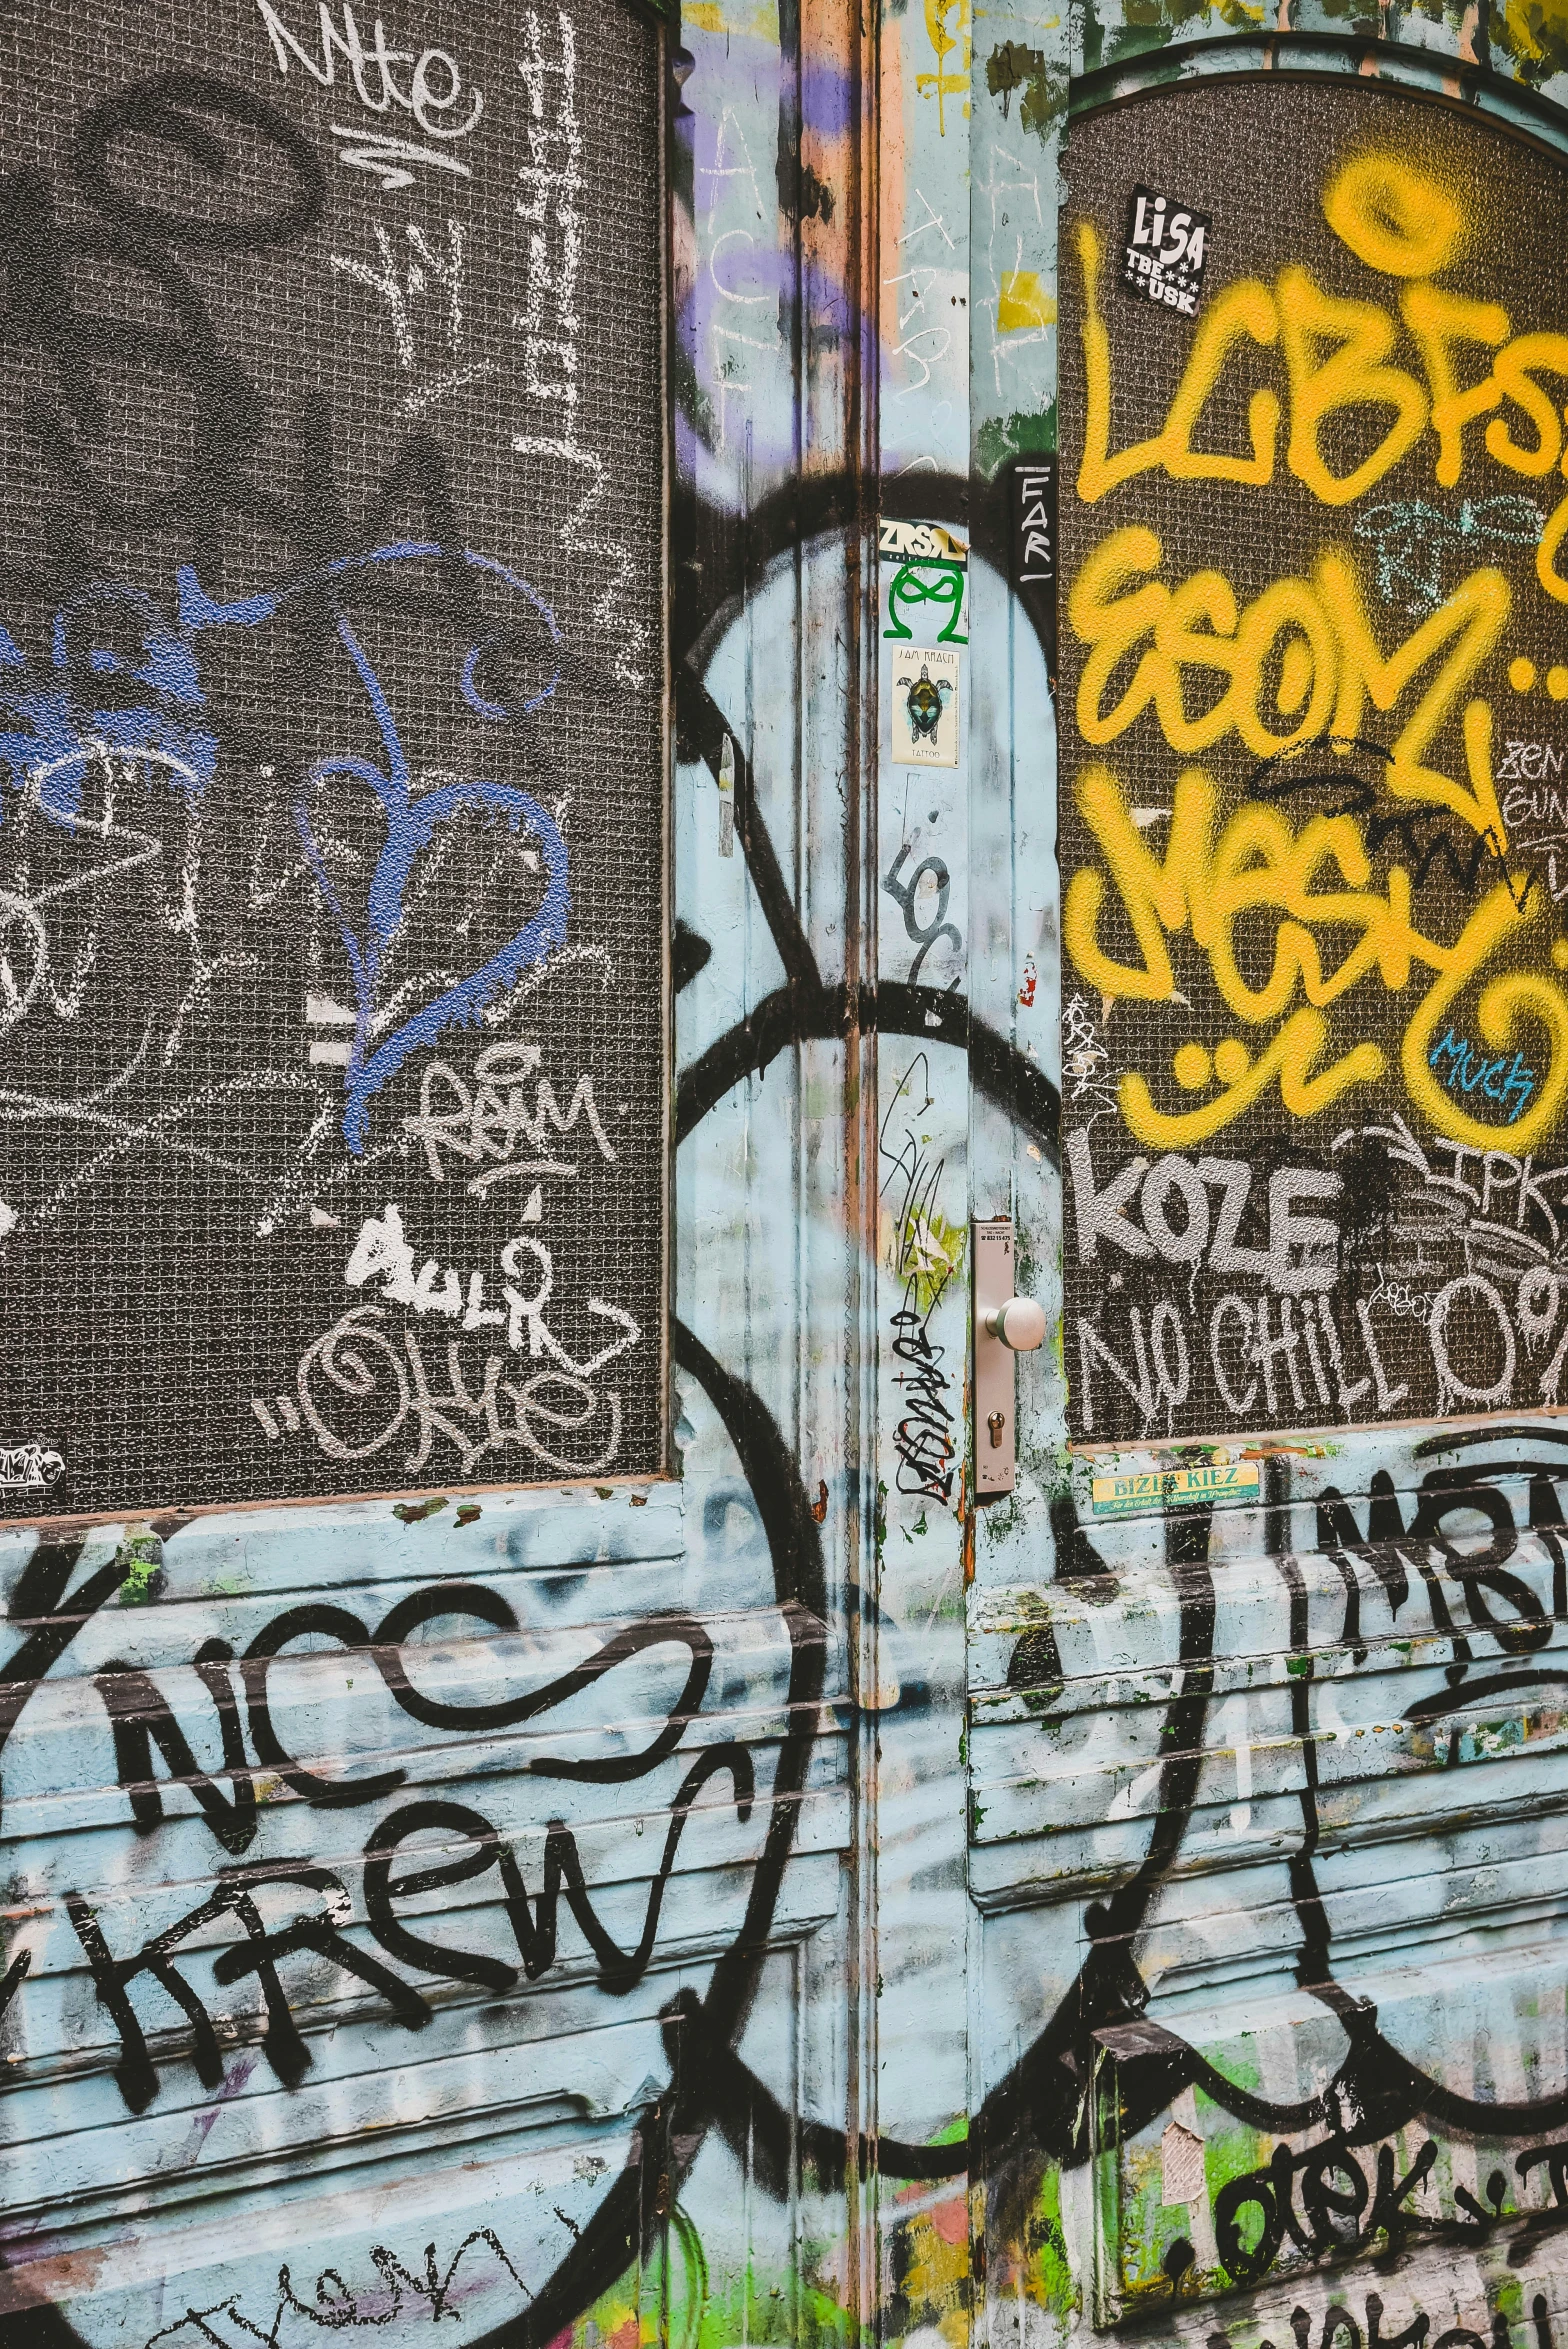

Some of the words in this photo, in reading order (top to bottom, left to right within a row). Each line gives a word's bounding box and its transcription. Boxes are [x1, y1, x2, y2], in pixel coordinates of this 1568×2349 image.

[1126, 247, 1165, 281] TBE
[1148, 277, 1196, 315] USK
[898, 648, 920, 661] SAM
[924, 651, 954, 664] KRACH
[912, 749, 941, 759] TATTOO
[1066, 1126, 1345, 1293] KOZE
[1077, 1299, 1190, 1432] NO
